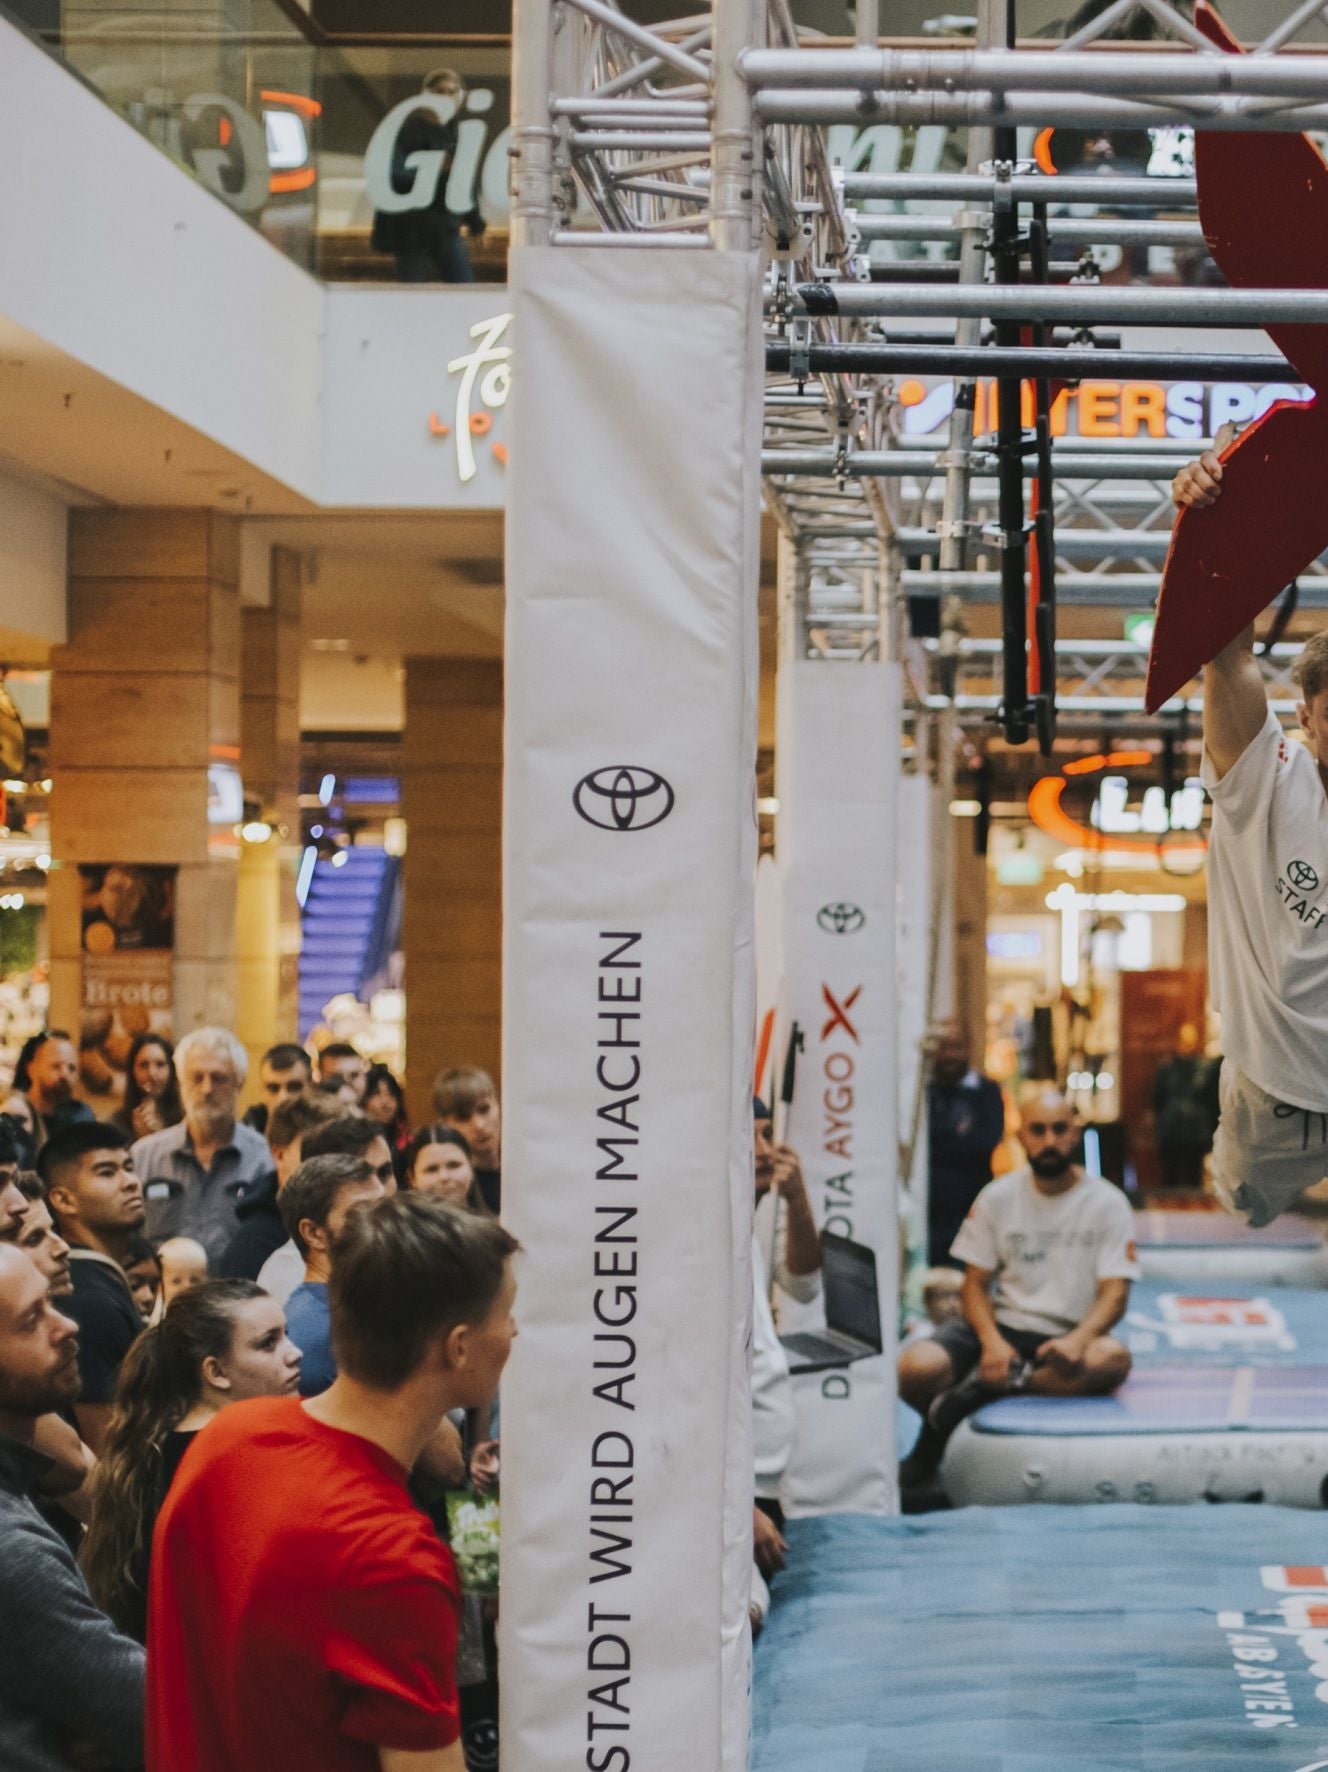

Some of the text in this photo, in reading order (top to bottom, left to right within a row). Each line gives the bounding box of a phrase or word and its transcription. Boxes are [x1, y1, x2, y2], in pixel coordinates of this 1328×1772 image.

[822, 1052, 856, 1159] AYGO
[585, 931, 643, 1772] STADT WIRD AUGEN MACHEN
